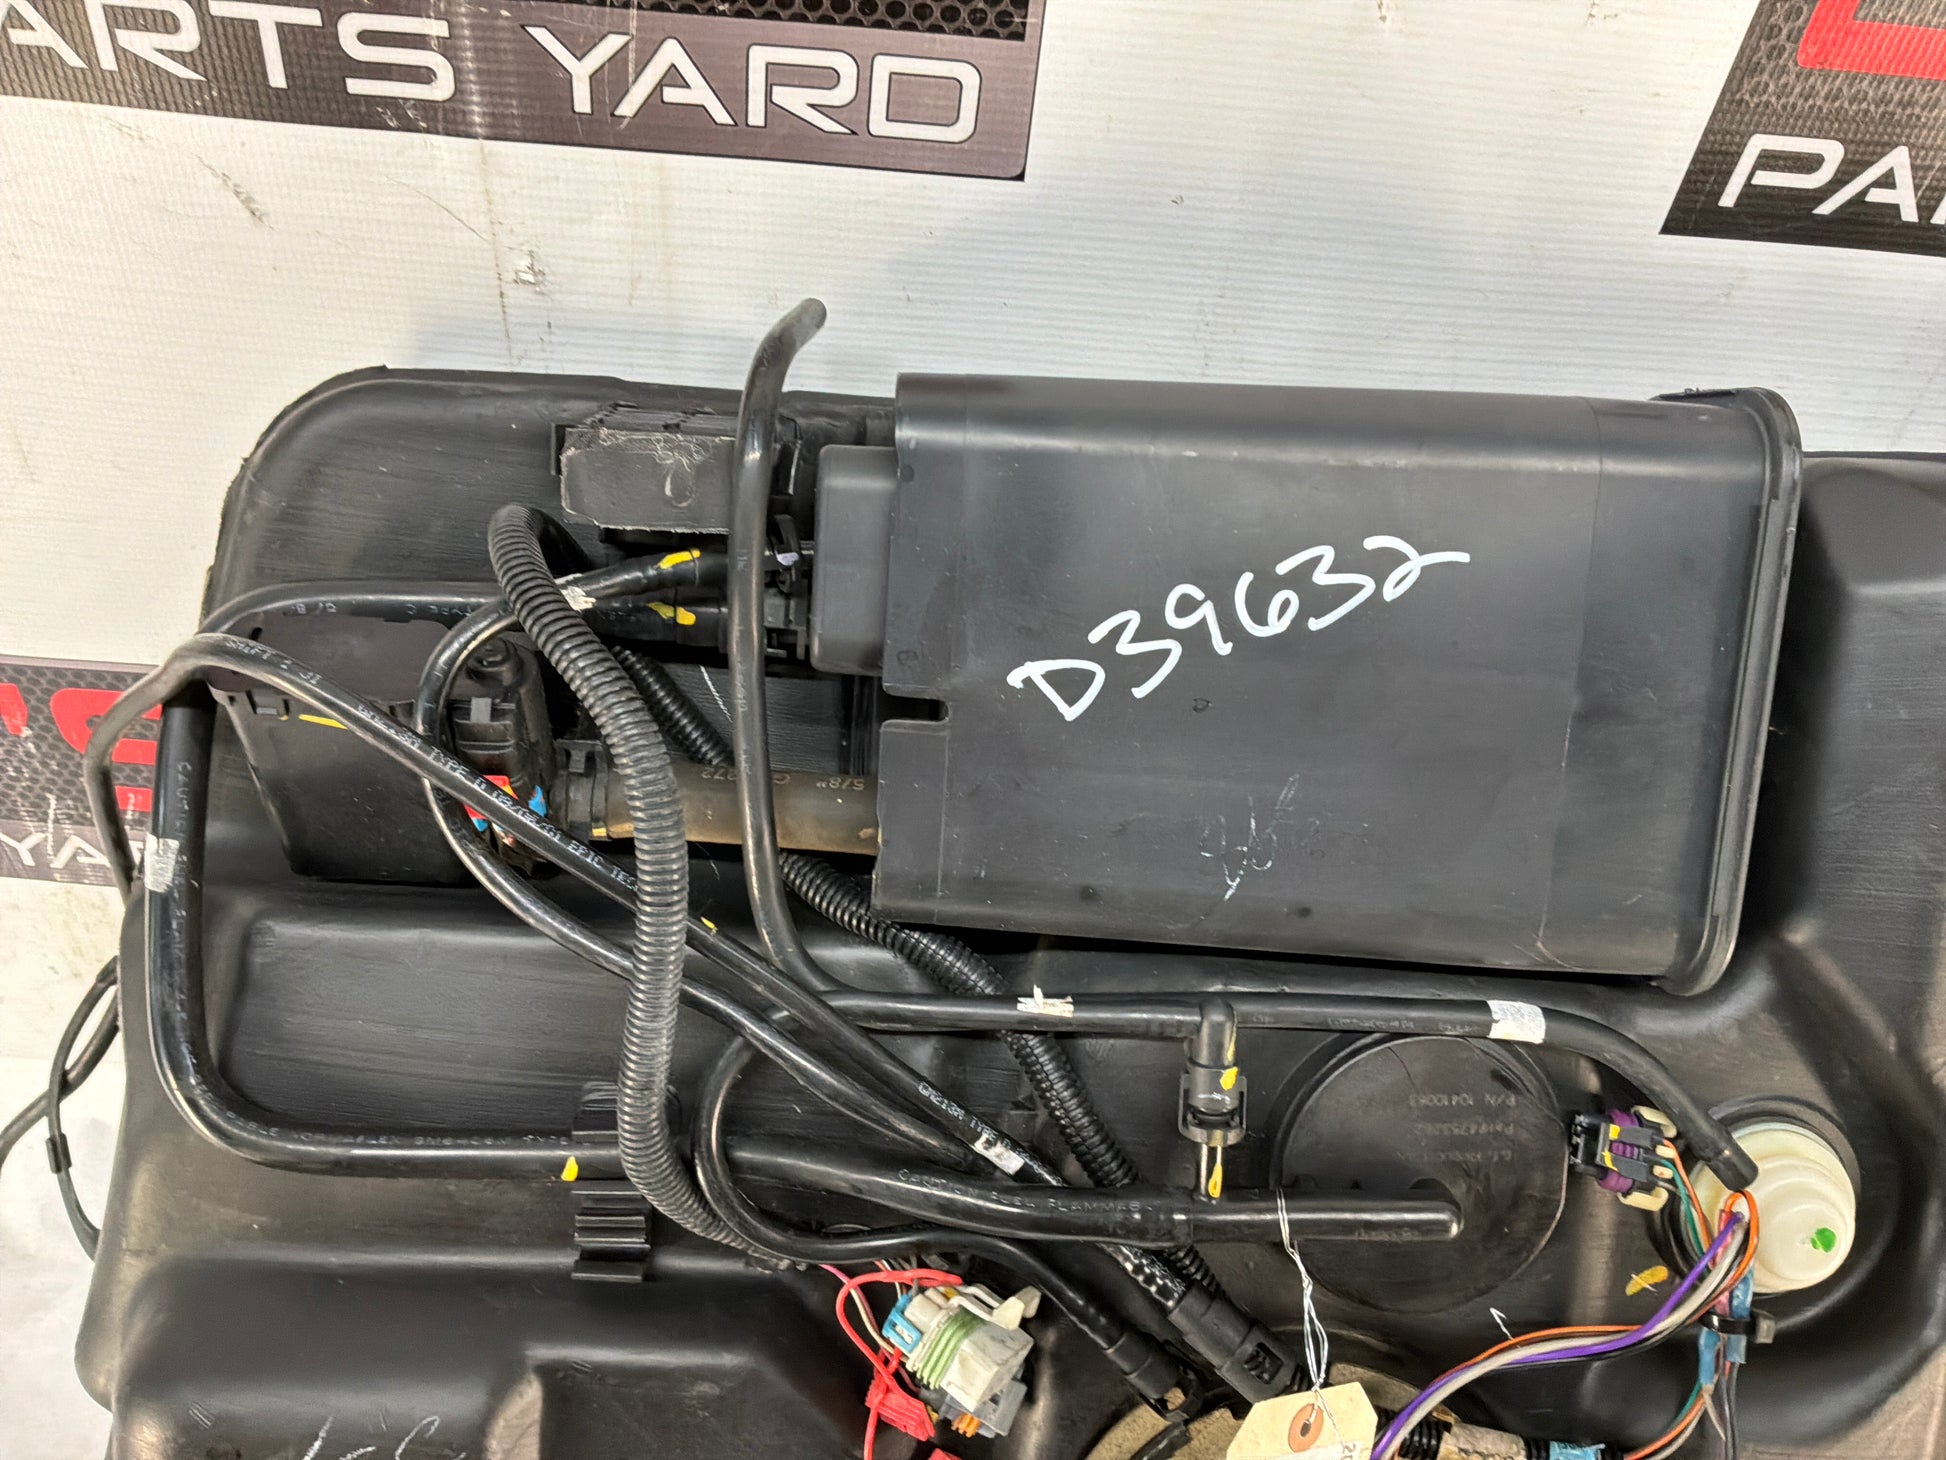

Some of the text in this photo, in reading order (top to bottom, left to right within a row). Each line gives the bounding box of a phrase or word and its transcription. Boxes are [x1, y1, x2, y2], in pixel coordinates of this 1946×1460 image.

[522, 25, 982, 144] YARD
[1718, 132, 1946, 225] PA
[1006, 534, 1472, 722] D39632
[568, 839, 604, 867] EPIC
